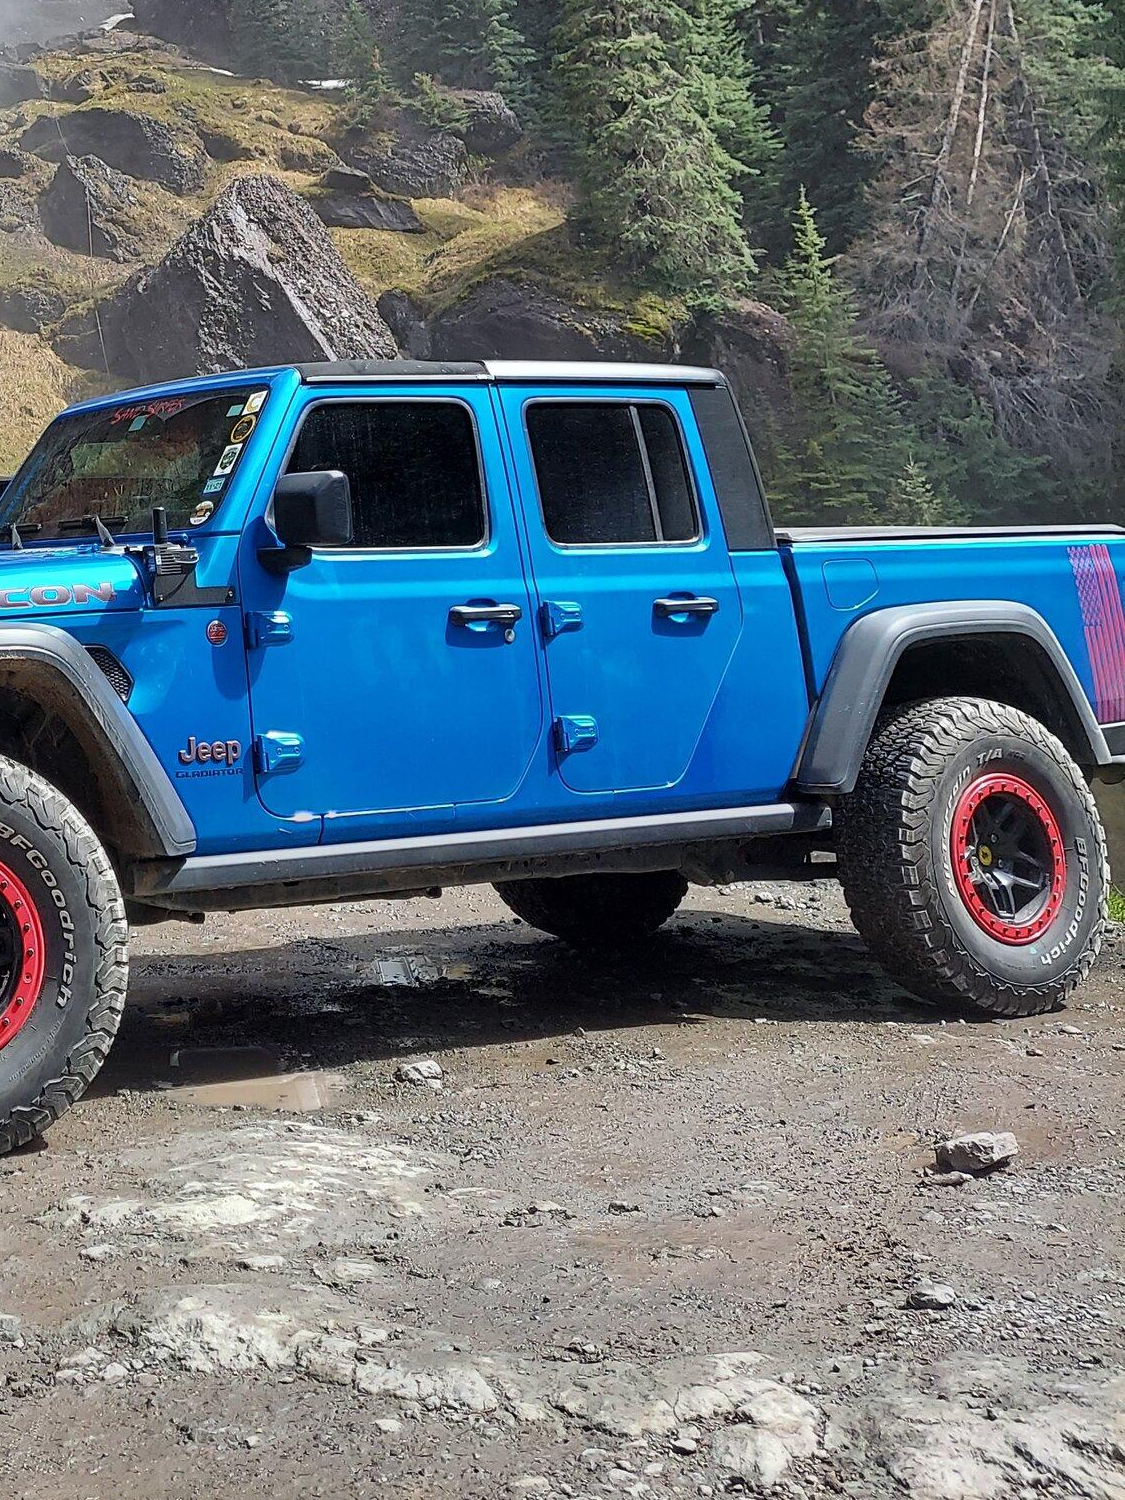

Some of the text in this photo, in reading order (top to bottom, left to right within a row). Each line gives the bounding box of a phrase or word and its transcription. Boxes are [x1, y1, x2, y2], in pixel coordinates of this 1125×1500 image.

[178, 736, 241, 766] Jeep
[976, 748, 1003, 765] T/A
[175, 767, 243, 779] GLADIATOR
[1039, 836, 1090, 966] BFGoodrich
